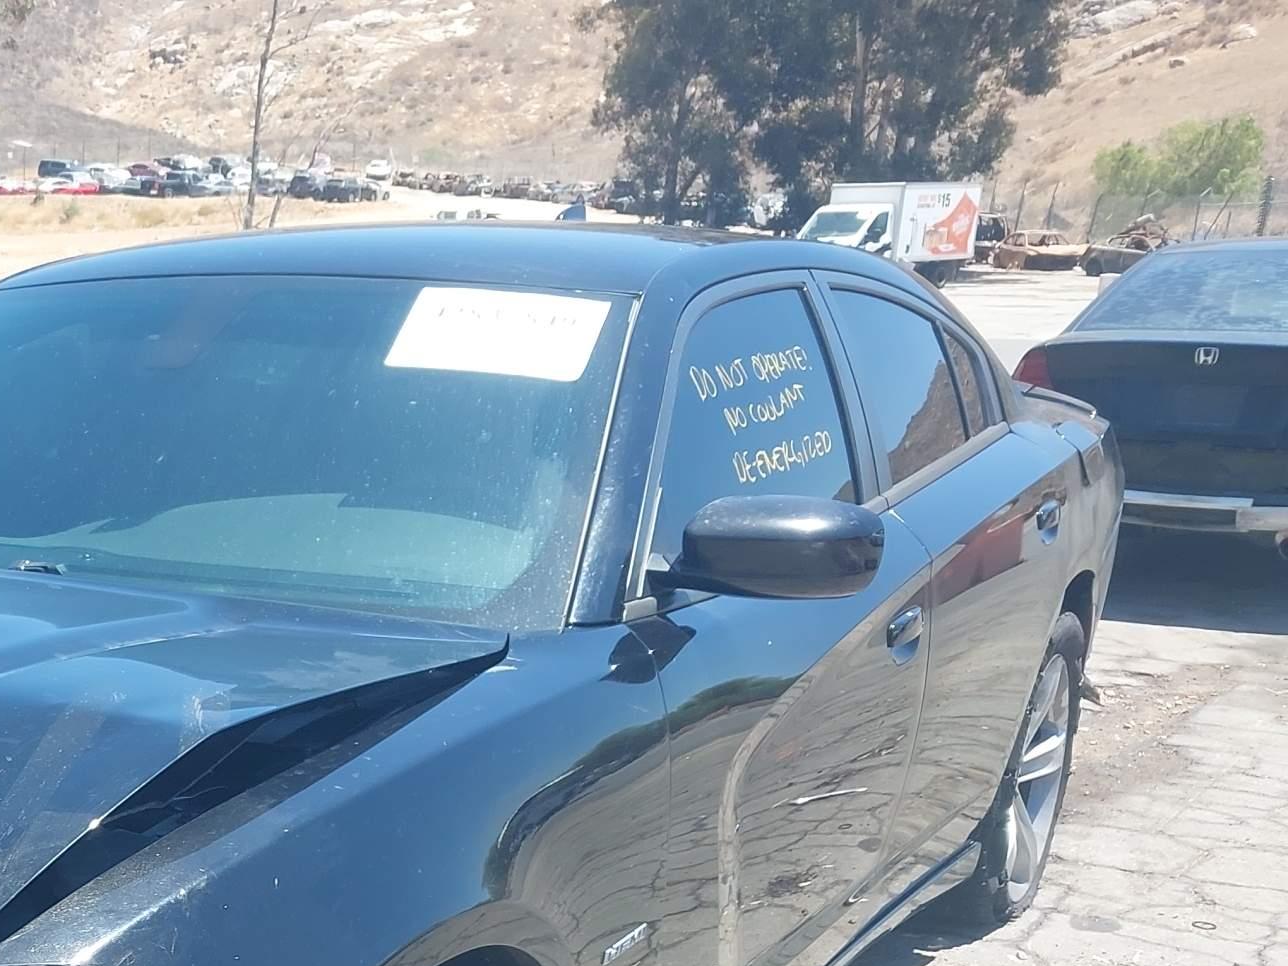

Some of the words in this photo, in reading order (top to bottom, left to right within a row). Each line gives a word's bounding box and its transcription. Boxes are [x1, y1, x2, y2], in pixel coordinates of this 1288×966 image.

[690, 366, 717, 401] DO
[715, 358, 748, 391] NOT
[723, 407, 747, 436] NO
